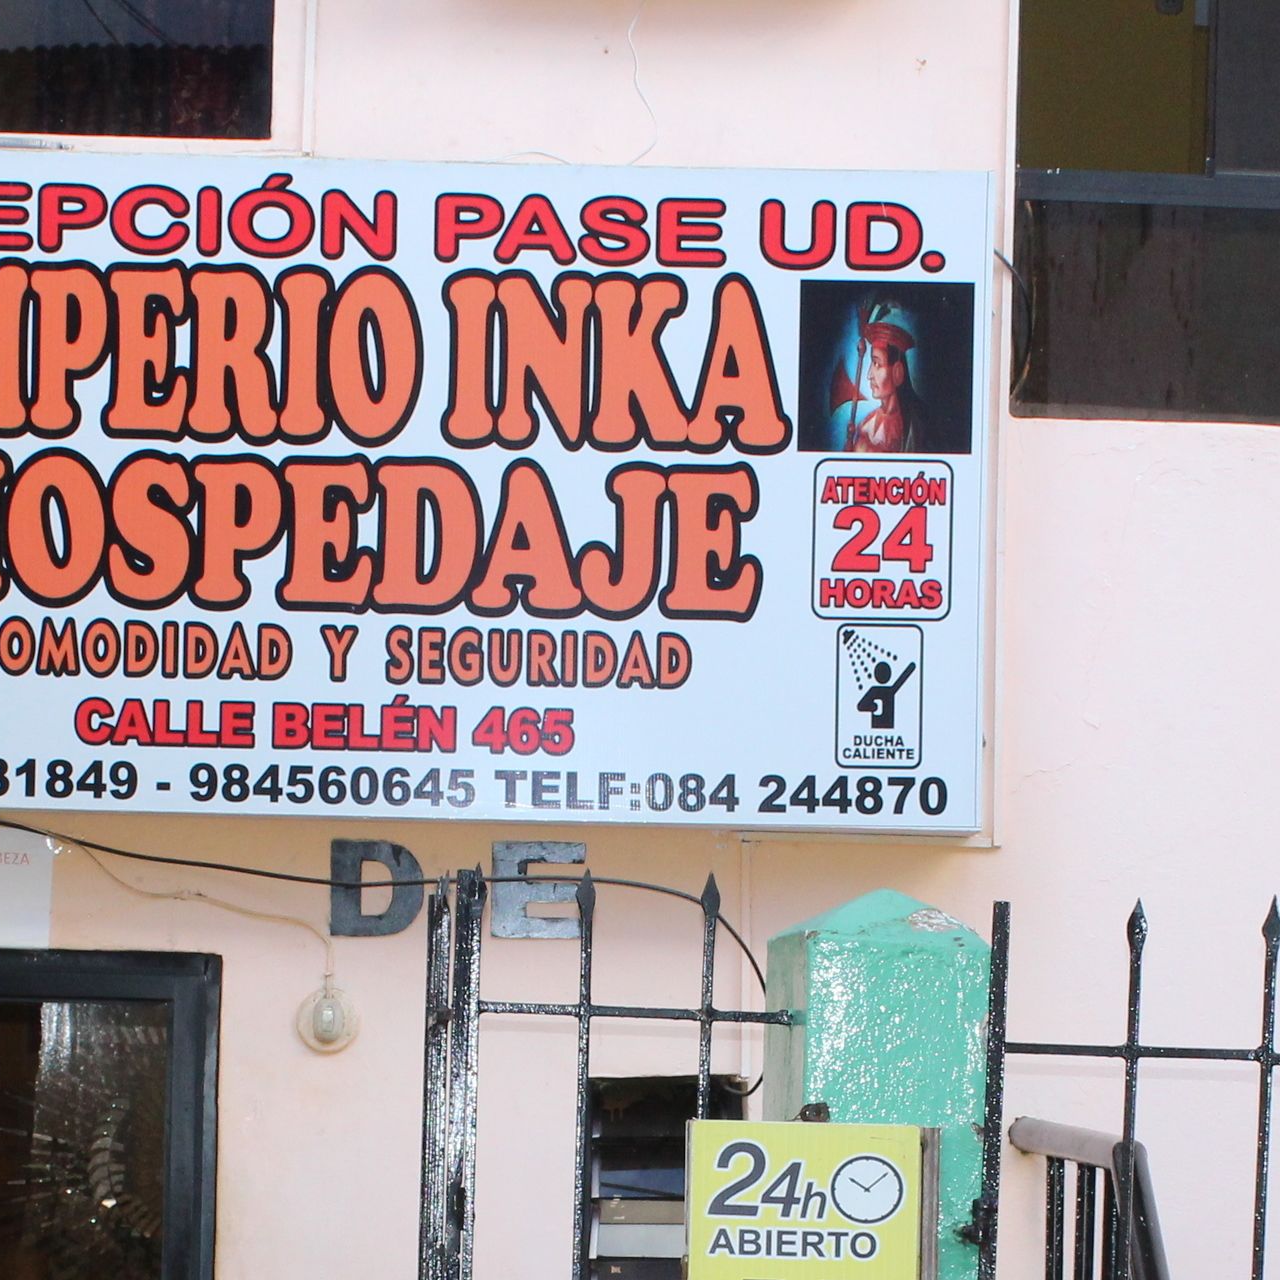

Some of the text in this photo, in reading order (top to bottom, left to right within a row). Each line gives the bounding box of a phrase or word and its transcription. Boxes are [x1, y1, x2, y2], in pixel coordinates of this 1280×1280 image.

[434, 192, 727, 267] PASE
[760, 198, 946, 273] UD.
[442, 271, 794, 456] INKA
[820, 471, 947, 506] ATENCIÓN
[831, 505, 934, 573] 24
[819, 577, 943, 610] HORAS
[320, 624, 360, 683] Y
[385, 626, 693, 690] SEGURIDAD
[74, 695, 576, 757] CALLE BELÉN 465
[853, 734, 906, 748] DUCHA
[842, 747, 915, 761] CALIENTE
[188, 762, 475, 808] 984560645
[757, 773, 948, 816] 244870
[707, 1229, 878, 1259] ABIERTO
